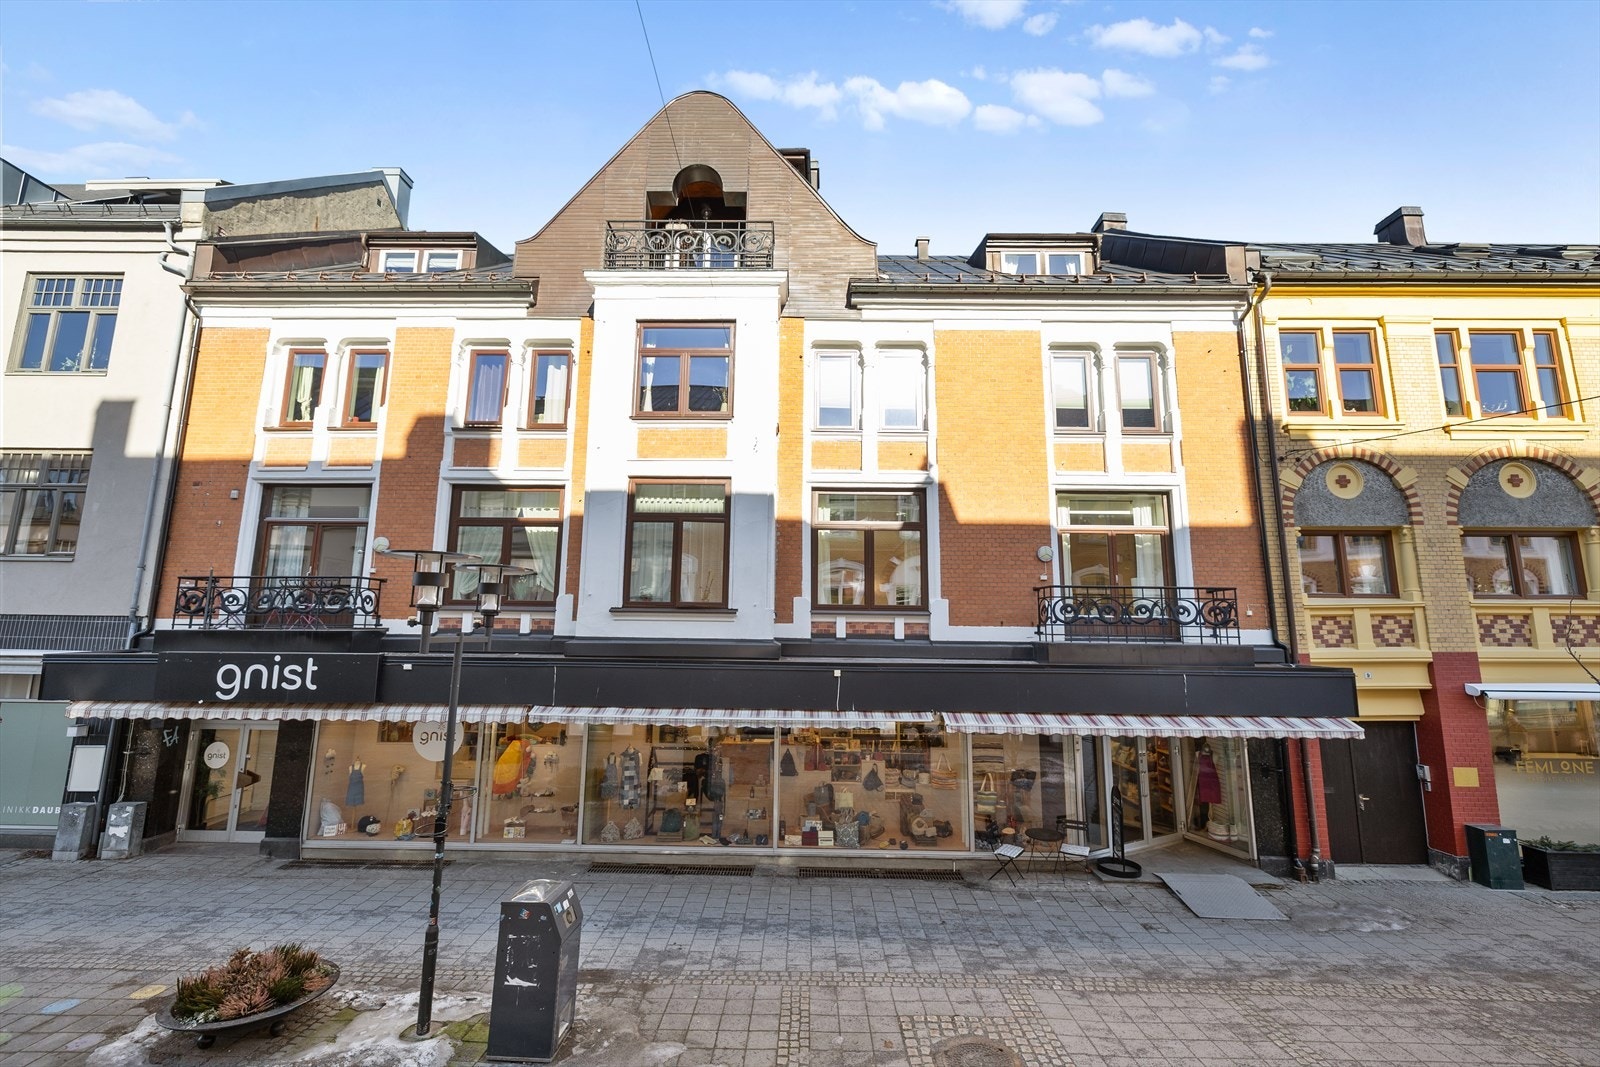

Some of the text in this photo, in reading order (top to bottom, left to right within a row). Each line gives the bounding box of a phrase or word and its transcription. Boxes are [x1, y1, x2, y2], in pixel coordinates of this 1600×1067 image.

[215, 654, 319, 701] gnist
[419, 731, 456, 745] gnis
[207, 750, 226, 761] gnist
